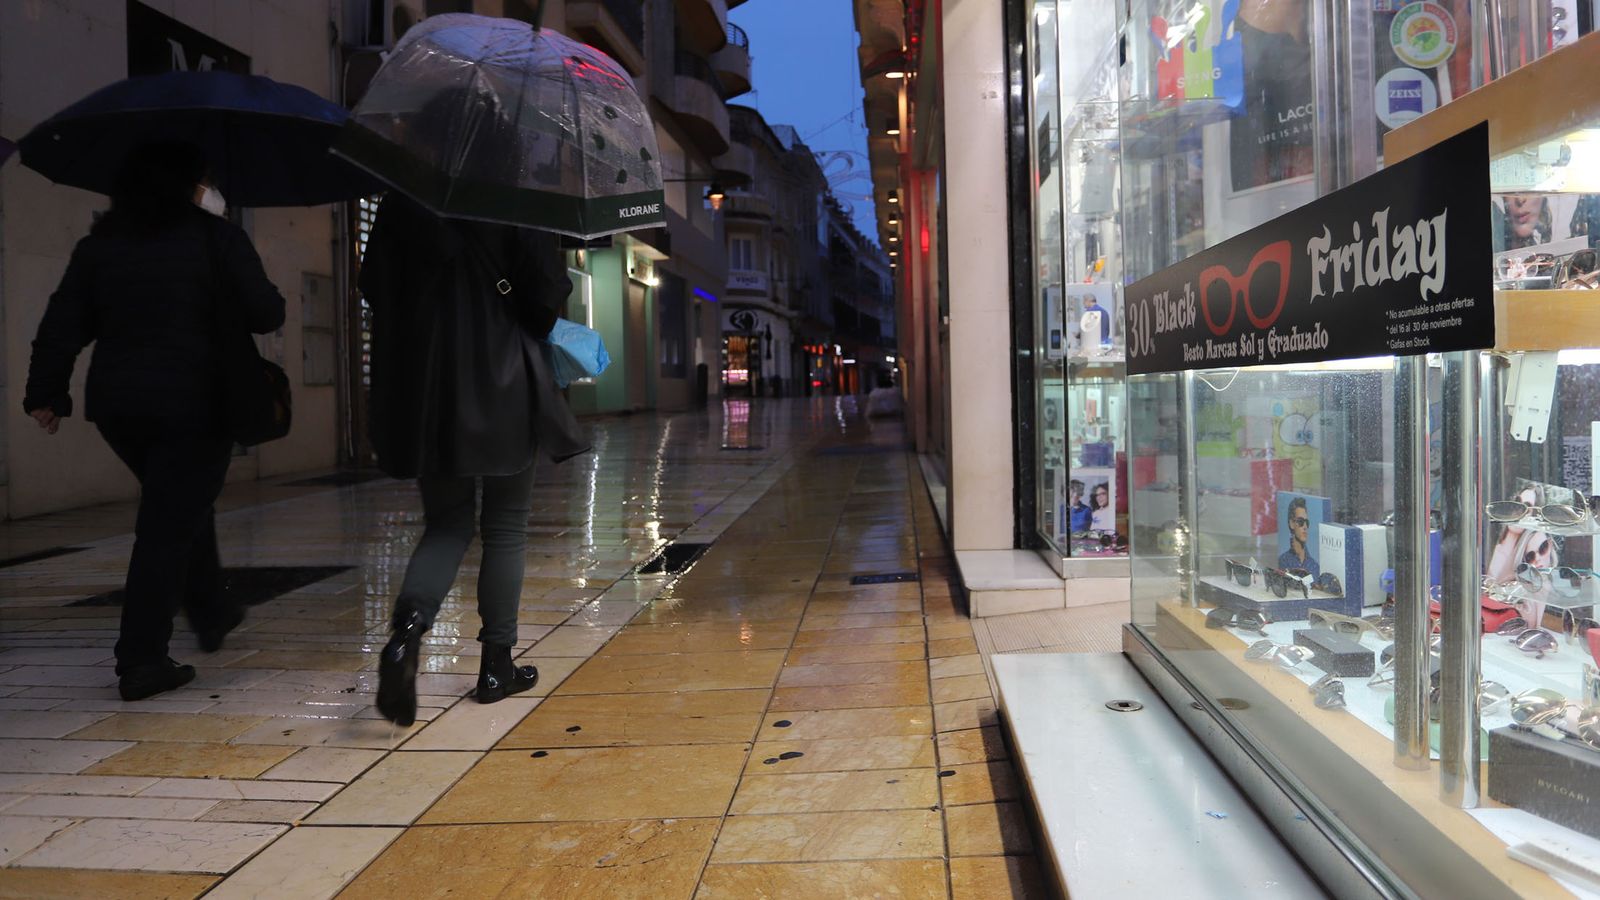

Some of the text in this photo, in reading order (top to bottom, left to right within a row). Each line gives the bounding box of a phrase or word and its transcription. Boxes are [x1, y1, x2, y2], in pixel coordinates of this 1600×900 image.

[1390, 89, 1421, 98] ZEISS
[1257, 131, 1276, 144] LIFE
[619, 203, 660, 218] KLORANE
[1153, 281, 1197, 335] Black
[1307, 205, 1448, 301] Friday
[1398, 304, 1429, 319] acumulable
[1435, 301, 1450, 312] otras
[1451, 297, 1475, 309] ofertas
[1405, 322, 1411, 332] al
[1413, 321, 1420, 332] 30
[1421, 320, 1429, 330] de
[1429, 316, 1462, 330] noviembre
[1183, 322, 1329, 363] Resto Marcas Sol y Graduado
[1405, 340, 1413, 348] en
[1413, 336, 1430, 348] Stock
[1321, 535, 1342, 548] POLO
[1537, 778, 1590, 804] BVLGARI
